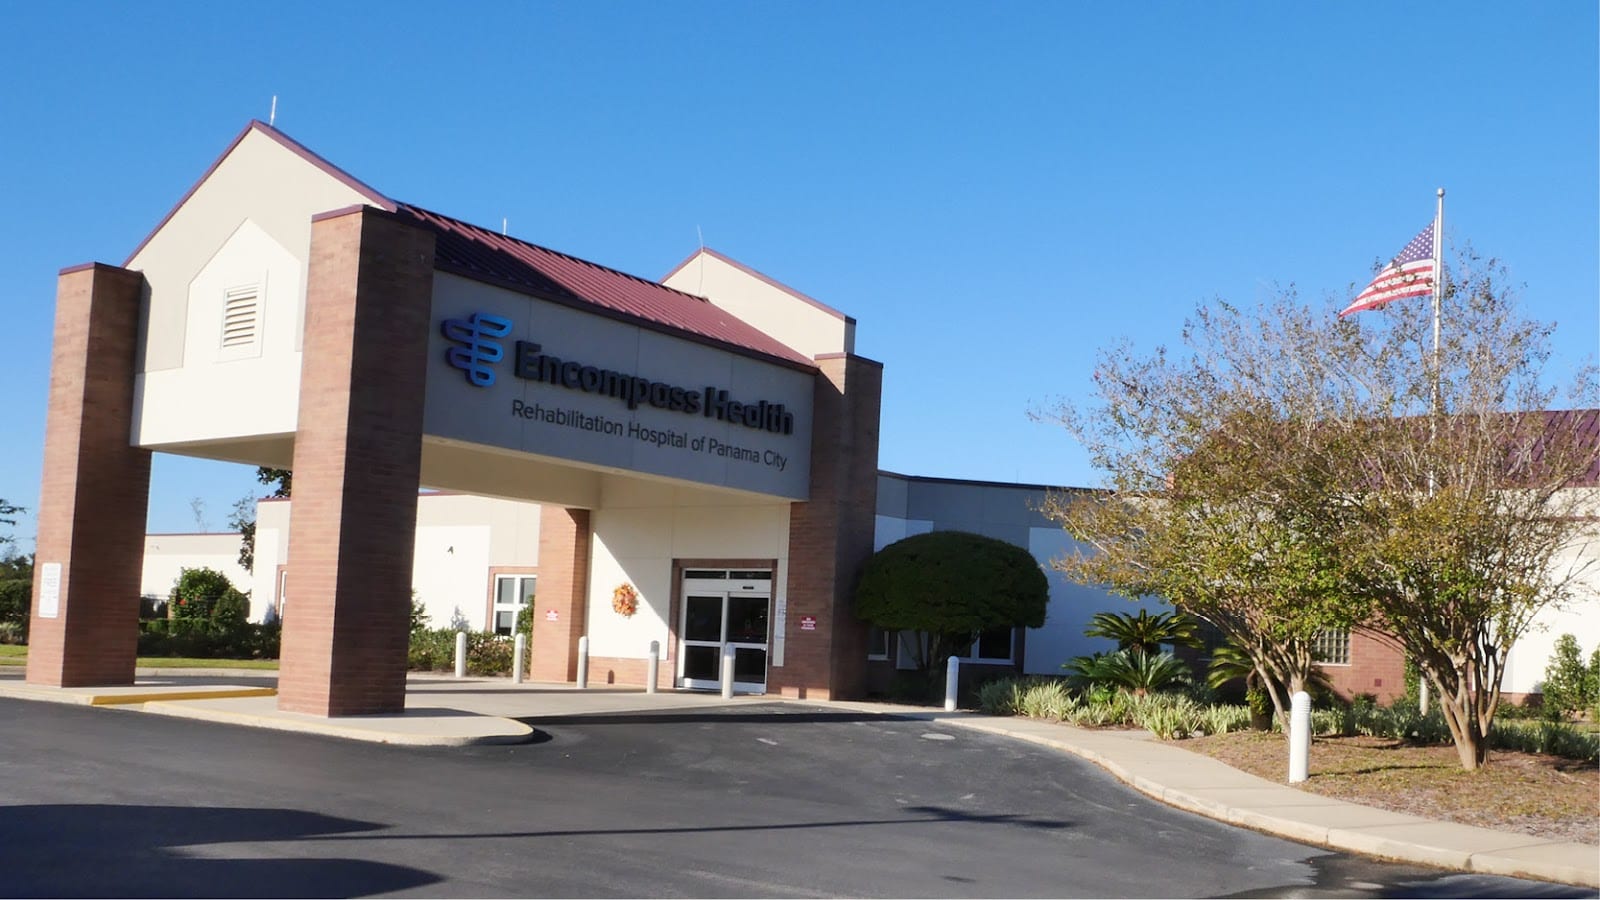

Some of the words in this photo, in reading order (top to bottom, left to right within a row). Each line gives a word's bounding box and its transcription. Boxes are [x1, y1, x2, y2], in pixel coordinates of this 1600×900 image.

[515, 340, 701, 414] Encompass
[704, 385, 794, 435] Health
[512, 400, 623, 436] Rehabilitation
[628, 420, 687, 449] Hospital
[691, 436, 706, 452] of
[709, 438, 760, 463] Panama
[764, 450, 787, 472] City
